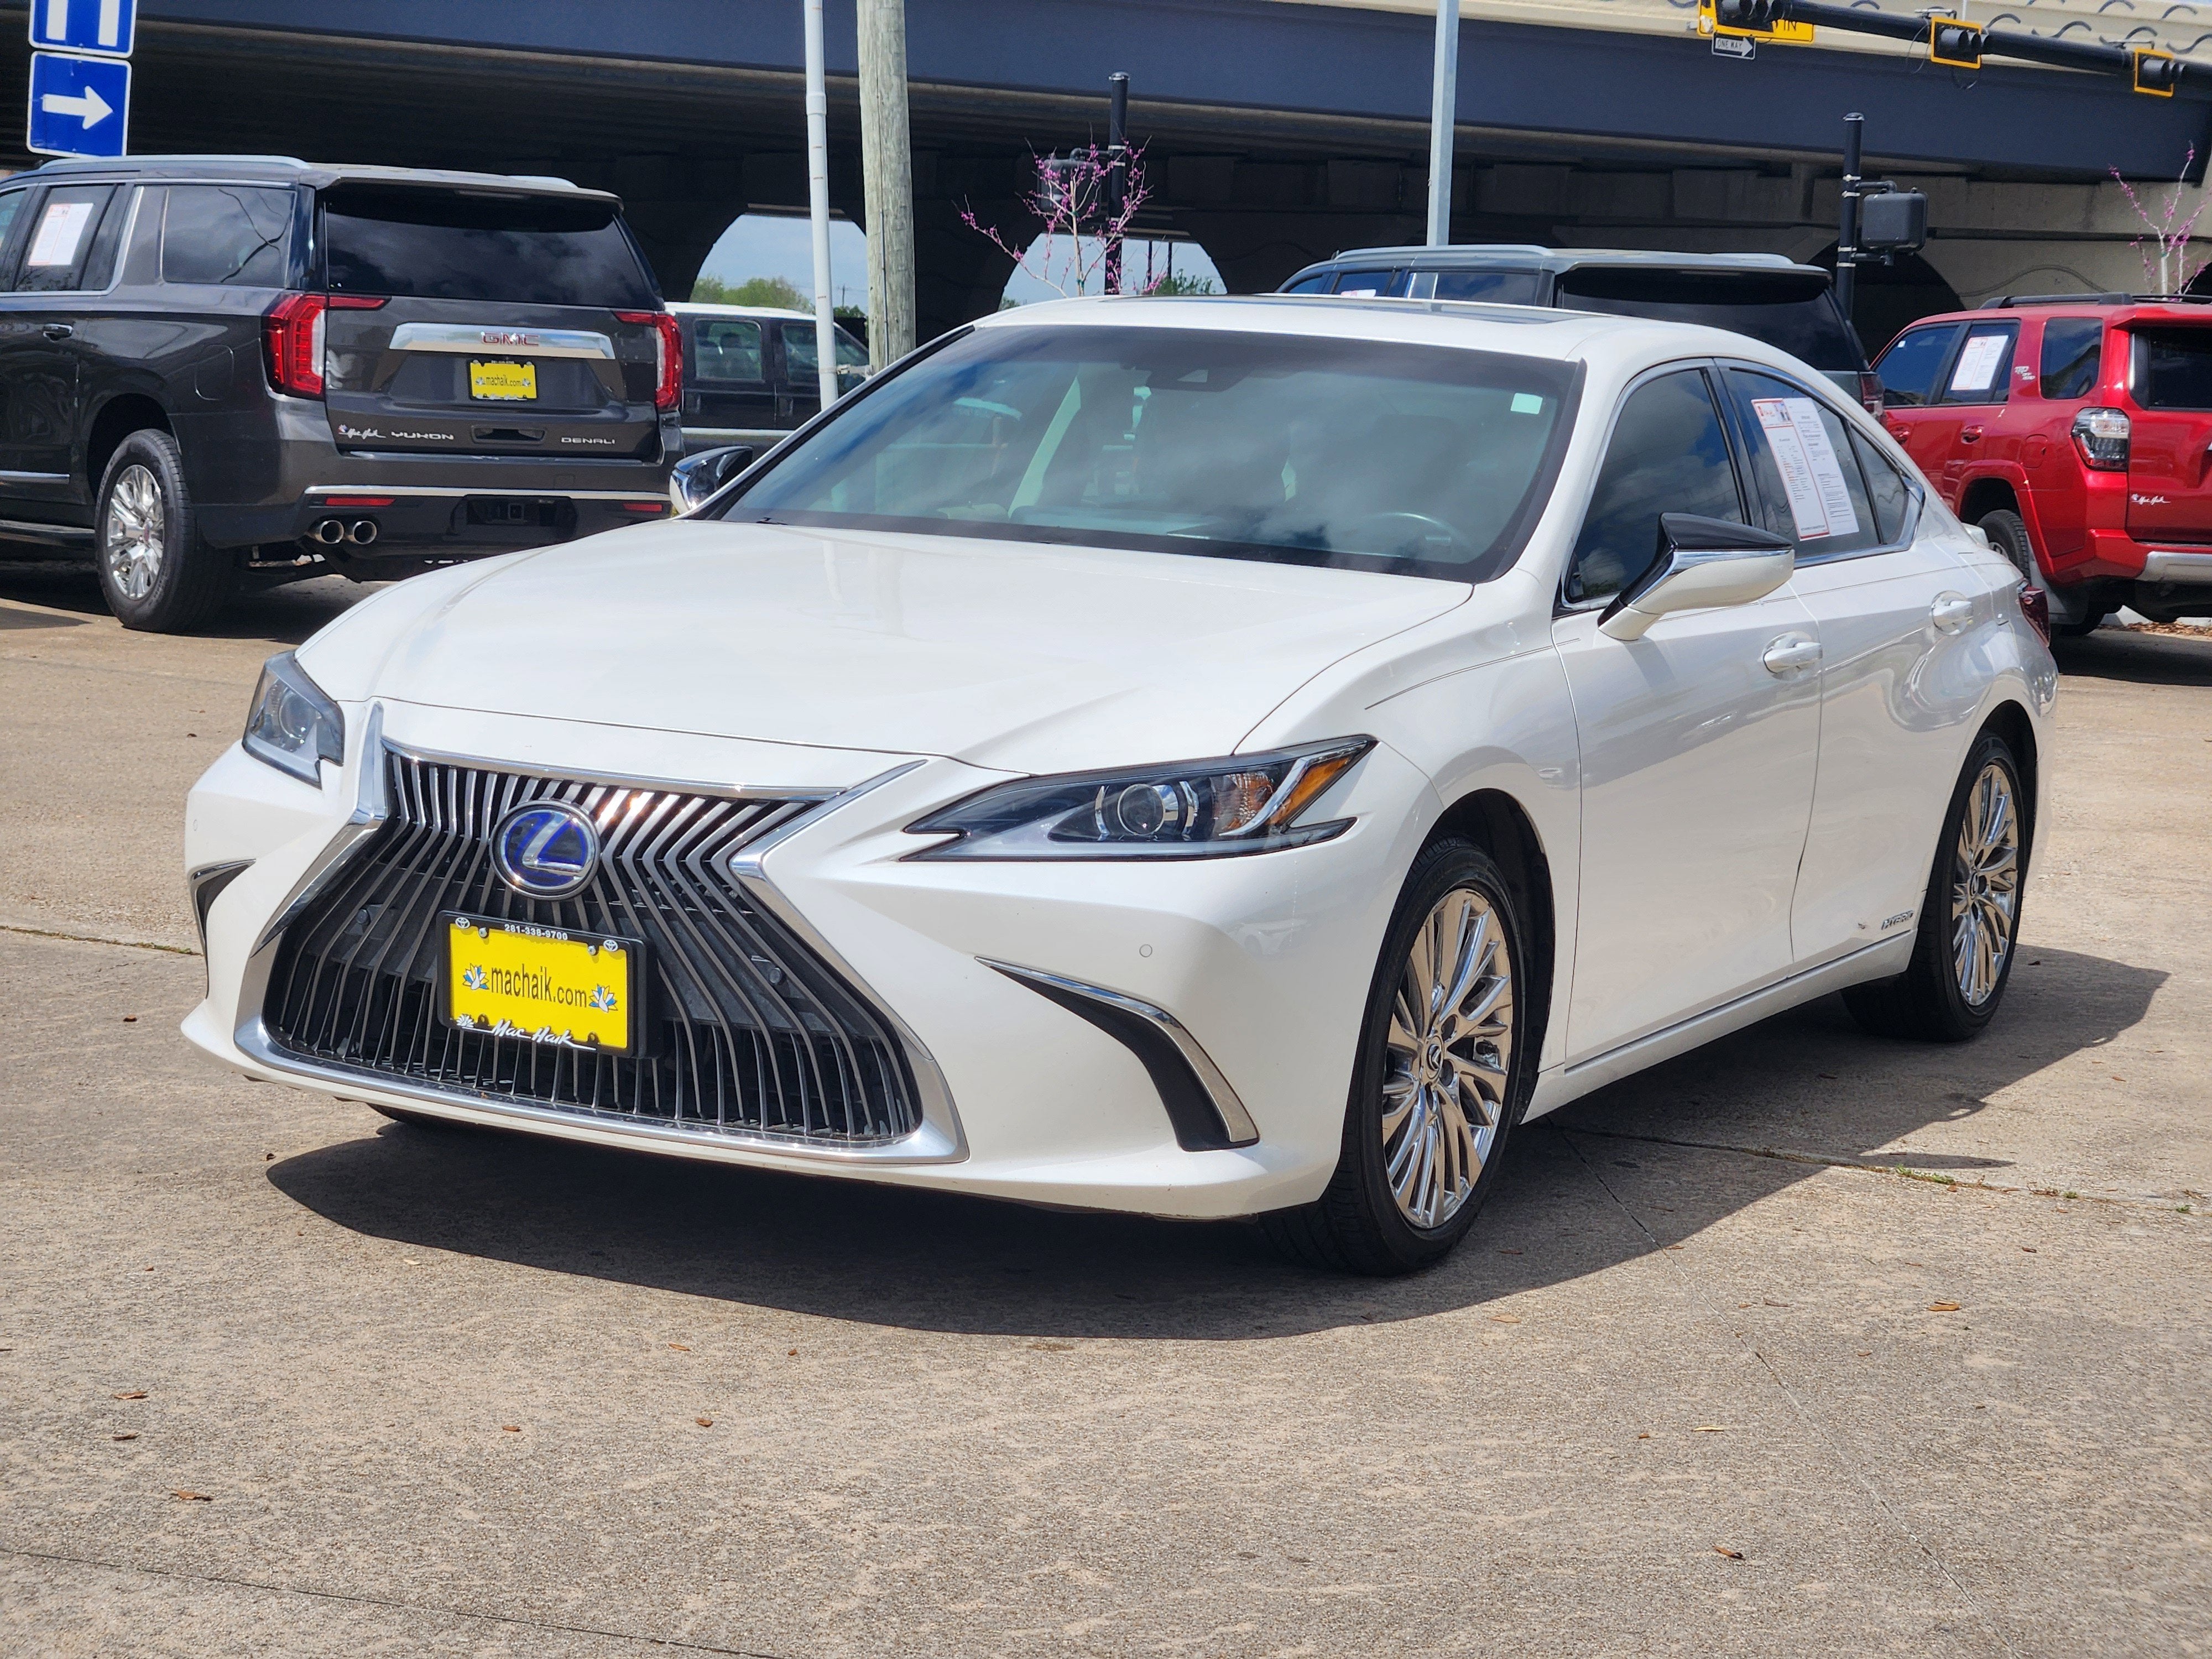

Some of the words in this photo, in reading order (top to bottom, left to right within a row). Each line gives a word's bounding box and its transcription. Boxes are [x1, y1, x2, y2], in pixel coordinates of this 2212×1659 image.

[1717, 39, 1729, 49] ONE
[1730, 41, 1742, 50] WAY
[481, 332, 540, 346] GMC
[391, 431, 454, 440] YUKON
[504, 923, 568, 941] 281-338-9700
[491, 963, 587, 1008] machaik.com
[462, 1019, 531, 1039] Mac
[530, 1026, 597, 1051] Haik
